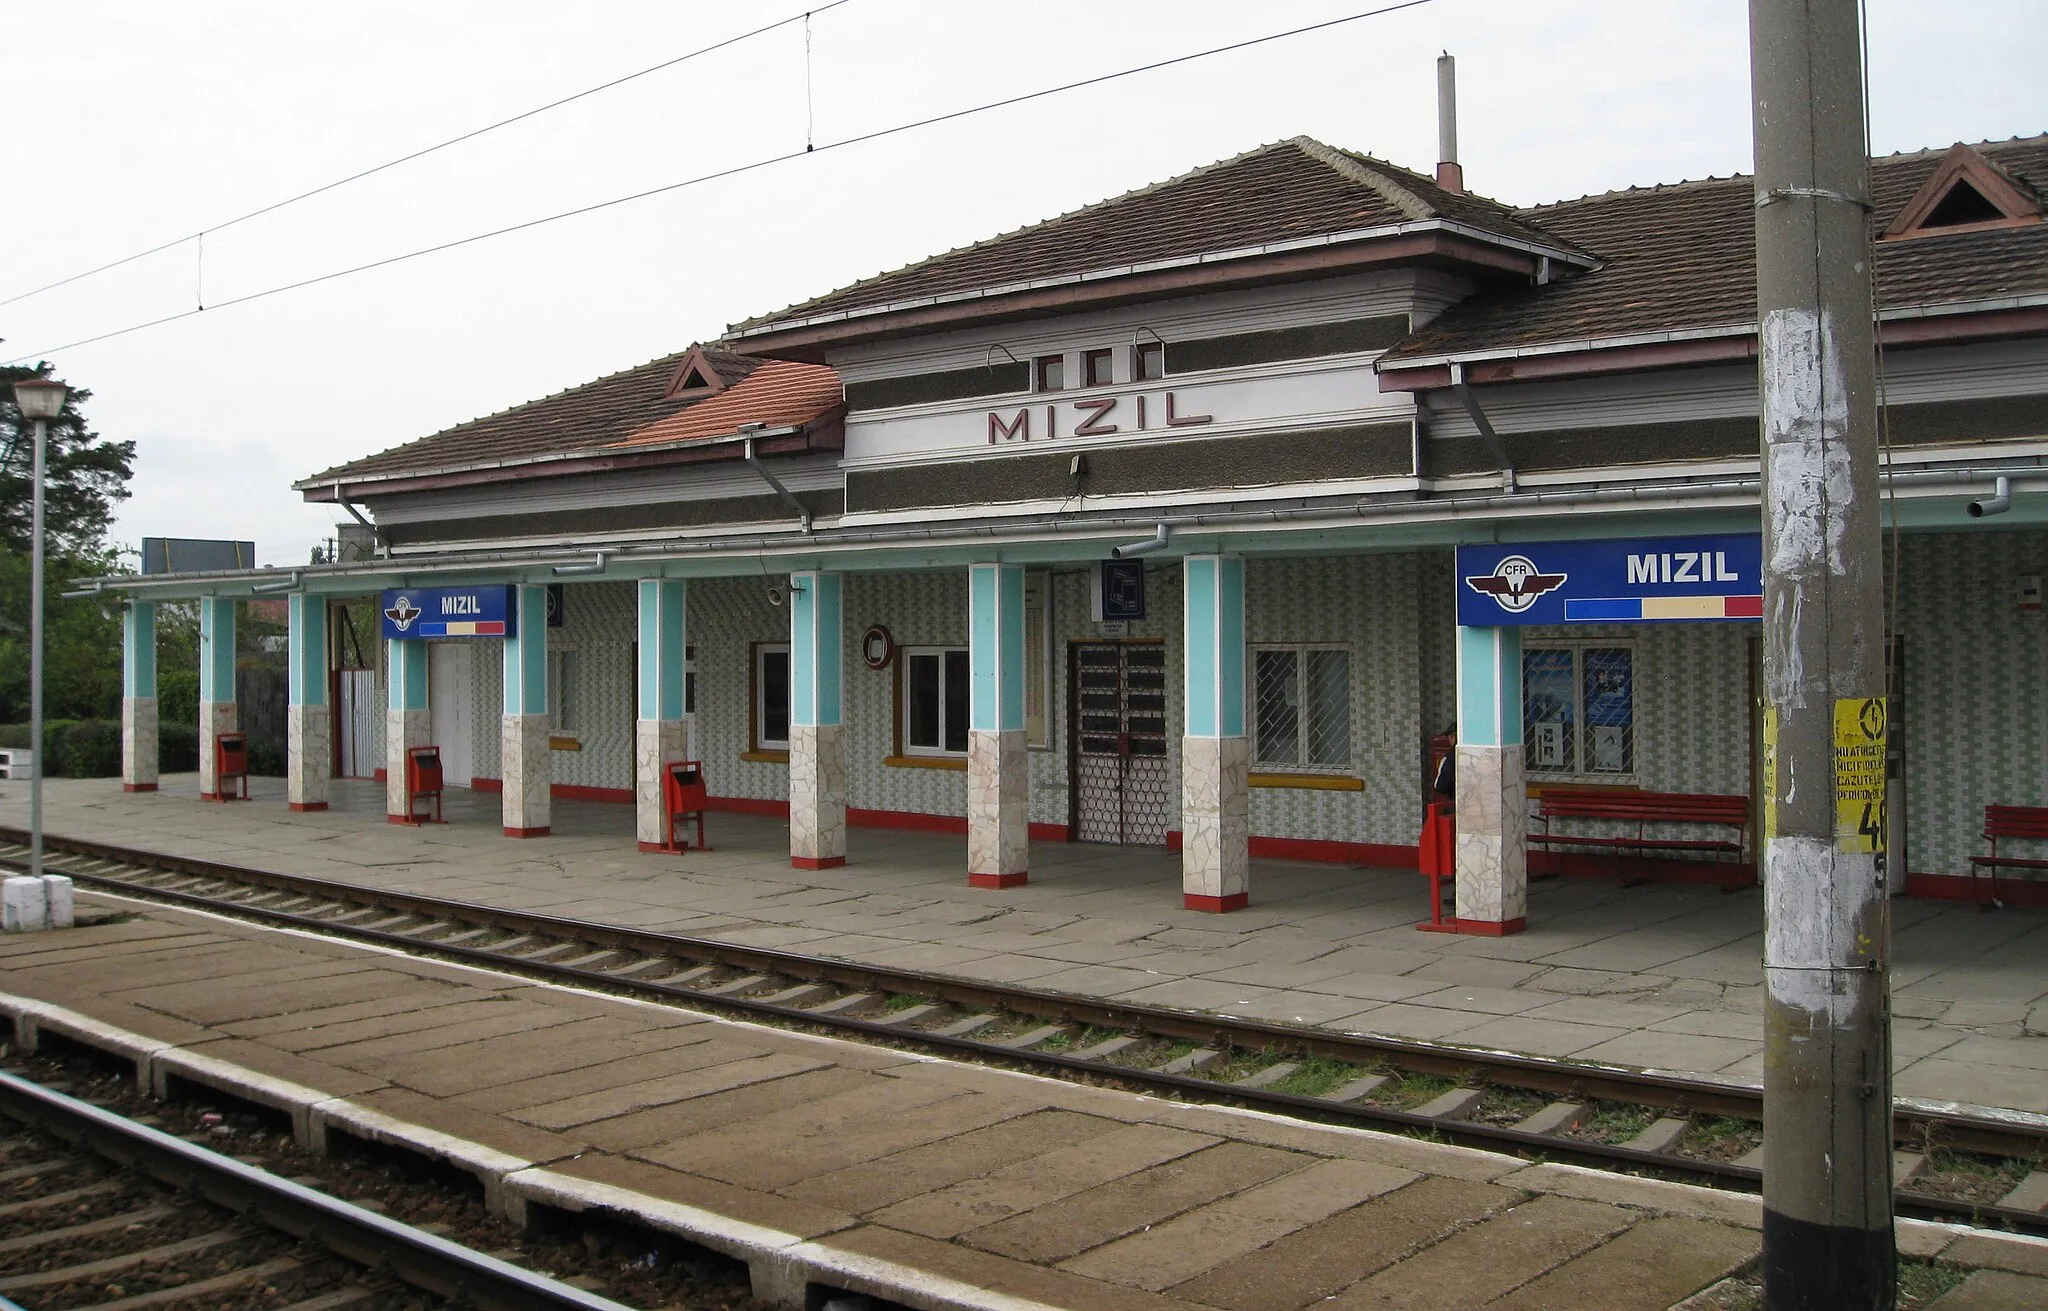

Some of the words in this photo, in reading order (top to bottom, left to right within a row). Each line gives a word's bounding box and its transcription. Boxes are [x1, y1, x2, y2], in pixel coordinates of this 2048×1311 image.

[987, 392, 1213, 445] MIZIL
[1504, 565, 1527, 576] CFR
[1627, 551, 1739, 584] MIZIL
[441, 596, 481, 615] MIZIL
